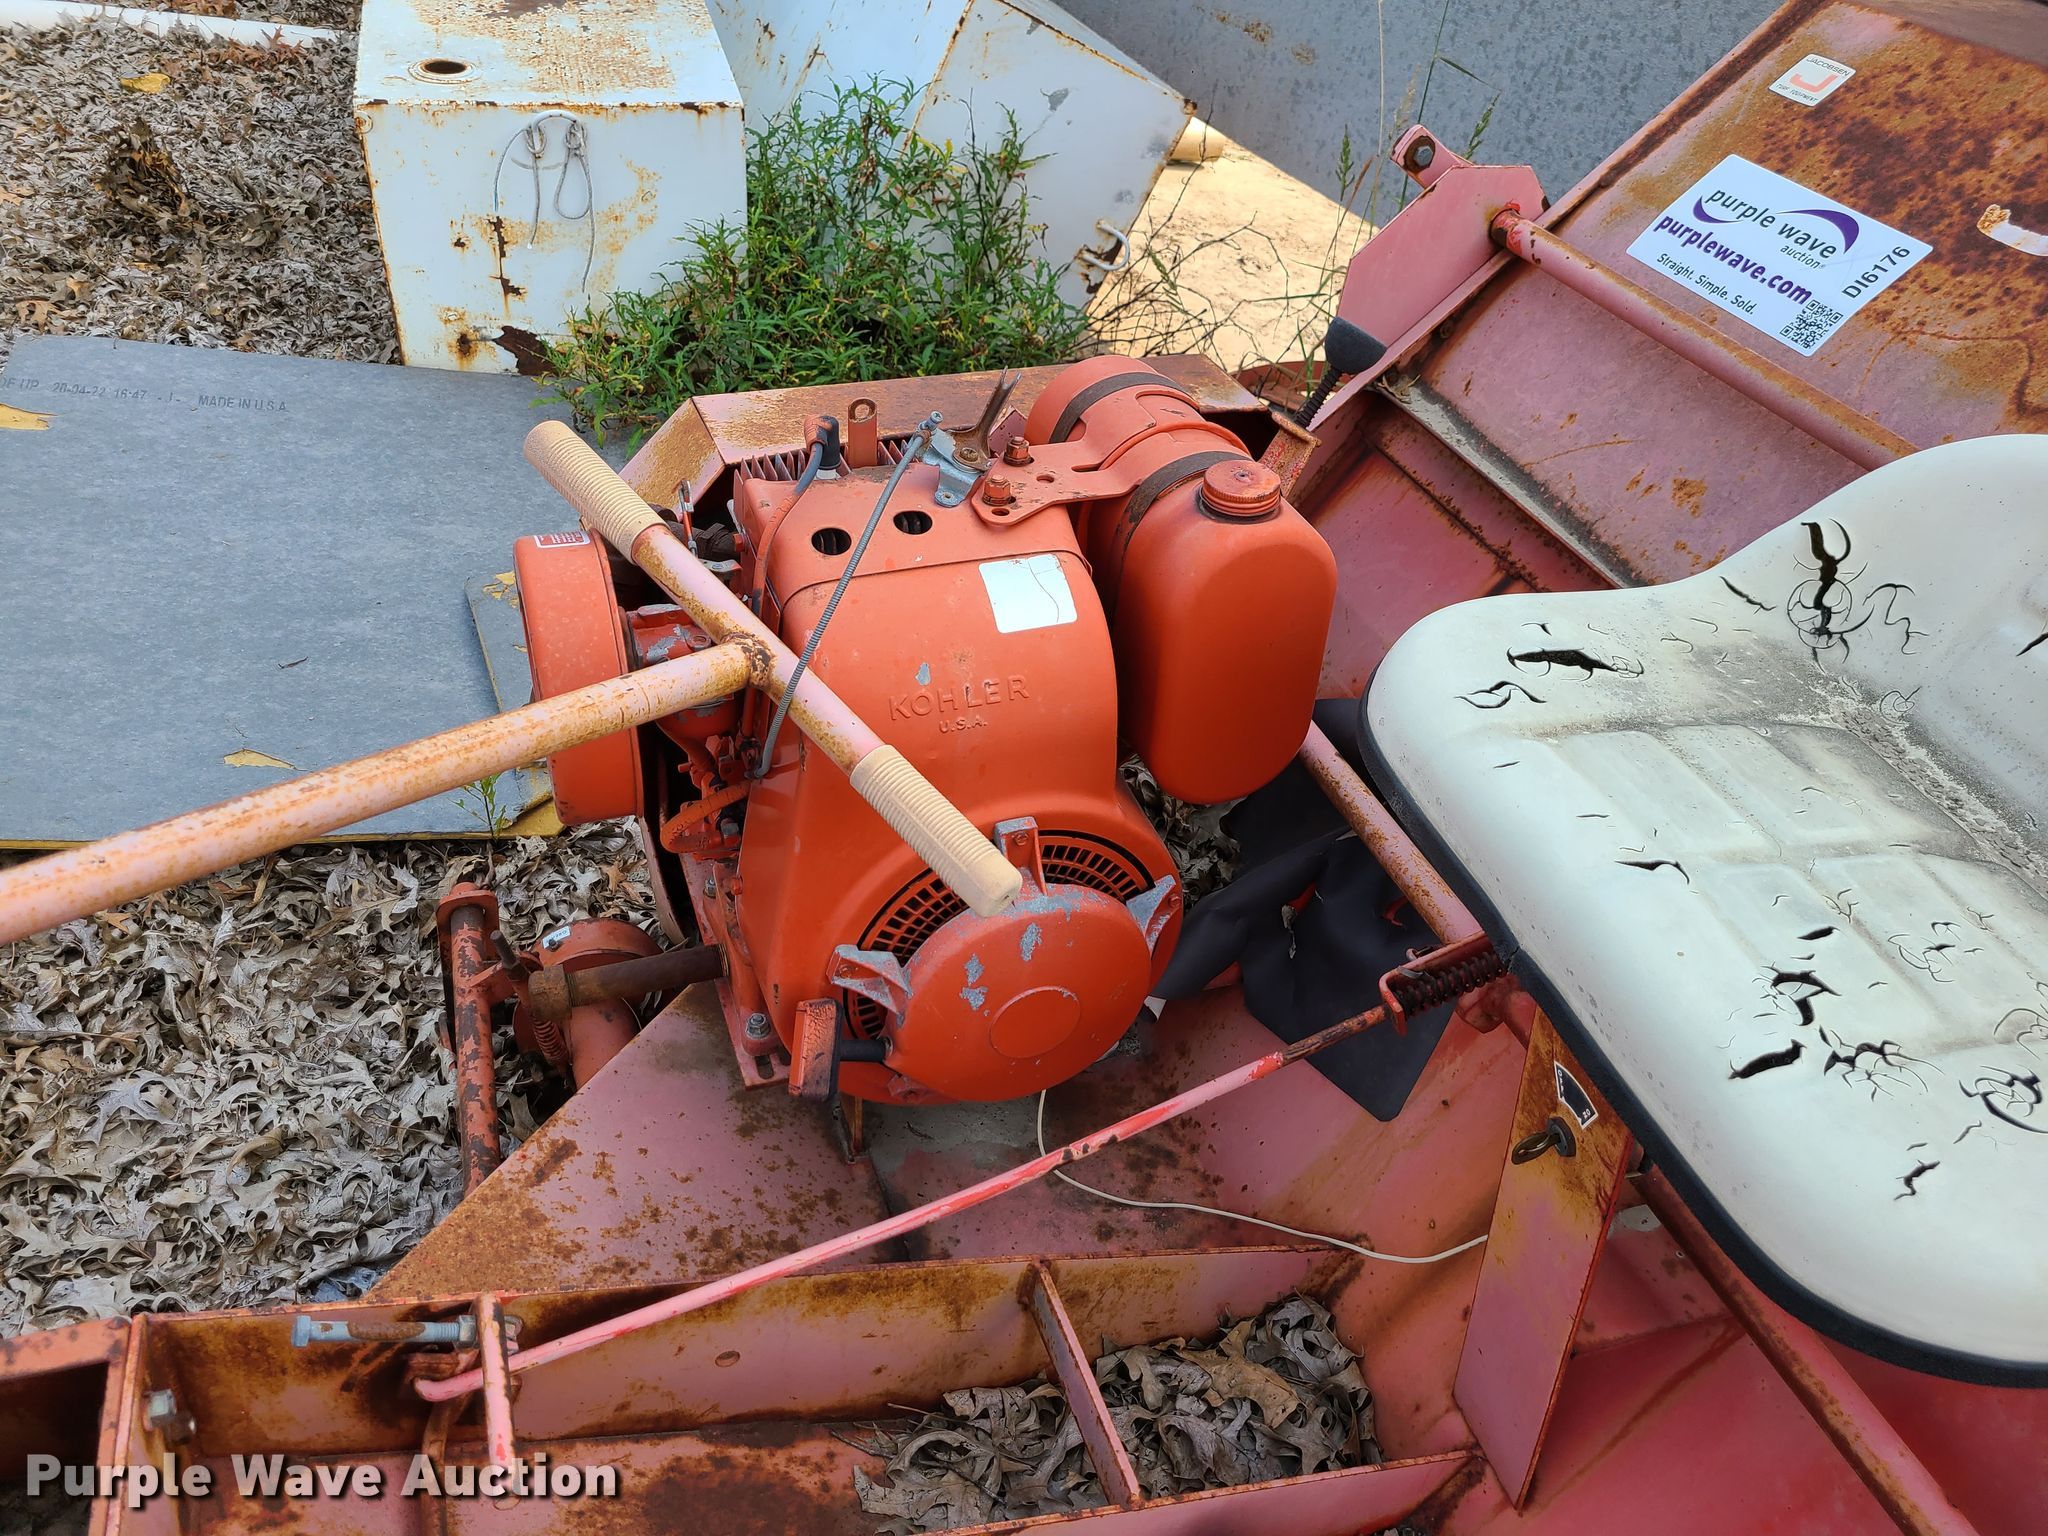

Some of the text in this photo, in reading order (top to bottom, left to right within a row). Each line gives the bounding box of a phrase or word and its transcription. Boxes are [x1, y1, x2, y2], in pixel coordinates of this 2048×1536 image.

[1806, 57, 1851, 77] JACOBSEN
[1705, 189, 1837, 259] purple wave
[1653, 215, 1813, 305] purplewave.com
[1657, 253, 1756, 315] Straight. Simple. Sold.
[1842, 246, 1911, 299] DI6176
[199, 395, 235, 408] MADE
[239, 398, 251, 409] IN
[888, 674, 1030, 721] KOHLER
